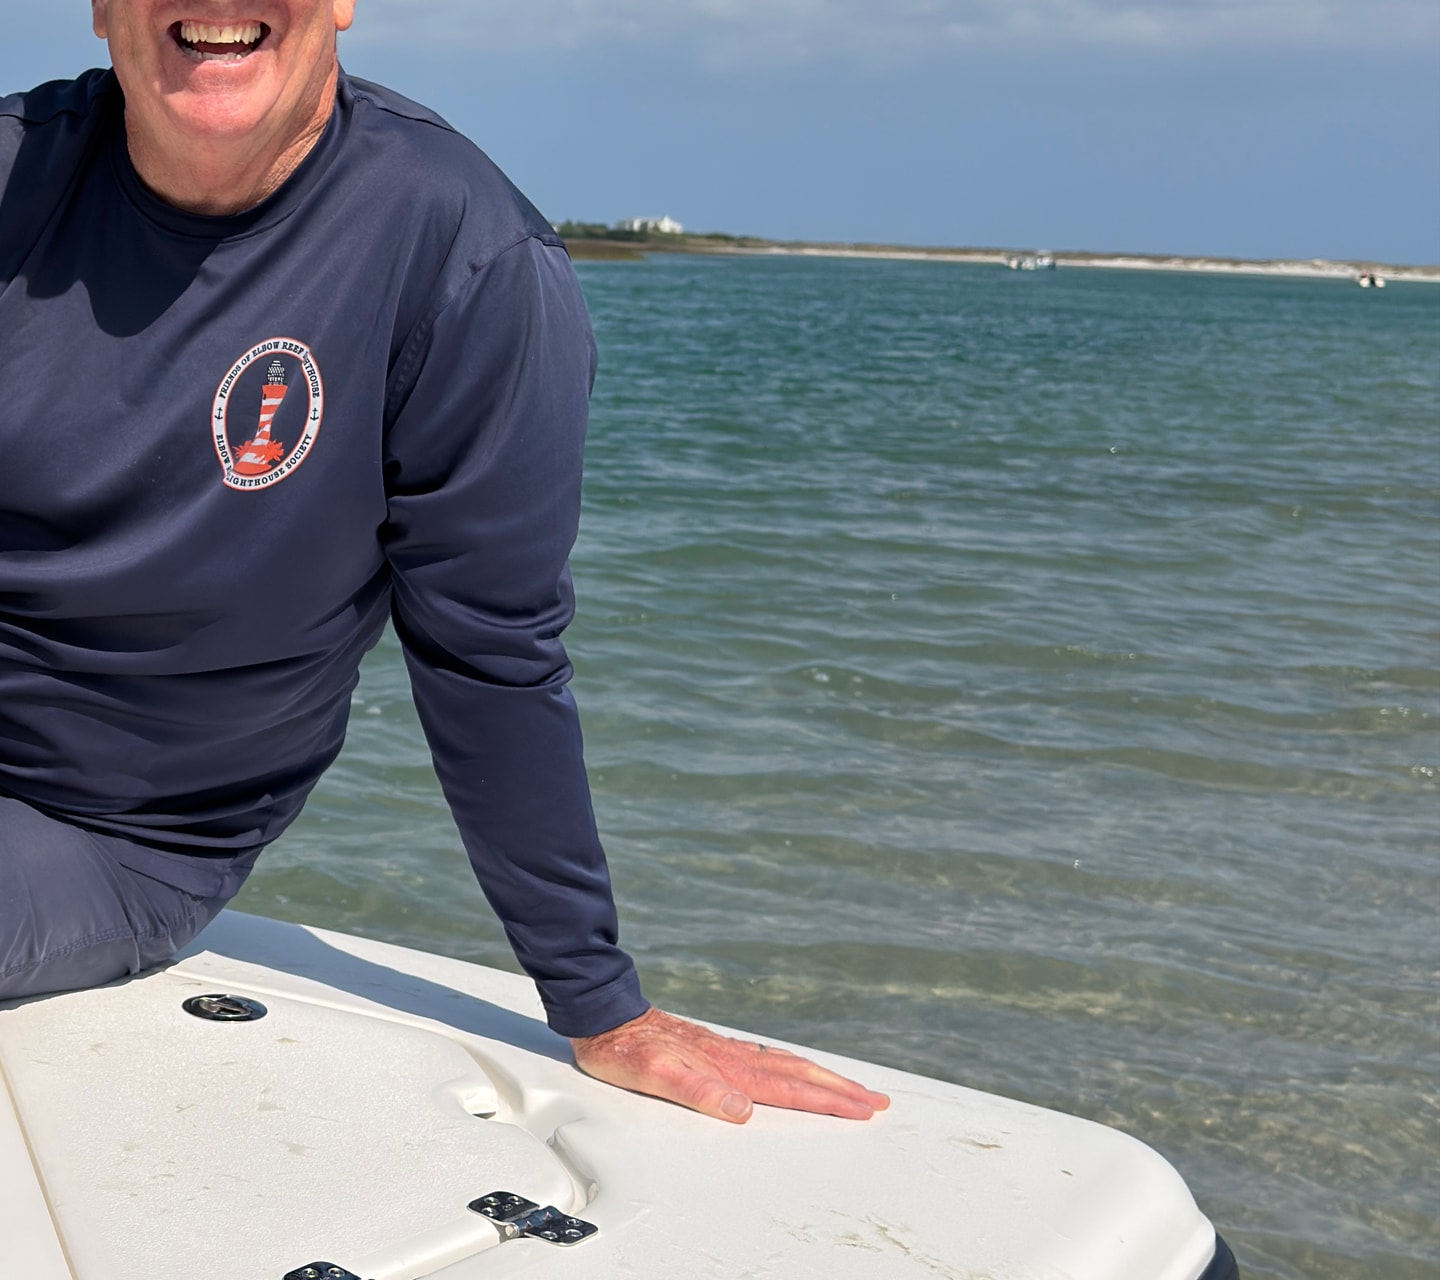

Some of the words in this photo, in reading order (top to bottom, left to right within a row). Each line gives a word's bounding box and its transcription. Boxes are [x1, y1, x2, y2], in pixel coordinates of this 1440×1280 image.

[219, 365, 242, 399] FRIENDS
[241, 355, 250, 366] OF
[252, 341, 280, 356] ELBOW
[282, 341, 304, 355] REEF
[216, 434, 231, 464] ELBOW
[286, 434, 312, 469] SOCIETY
